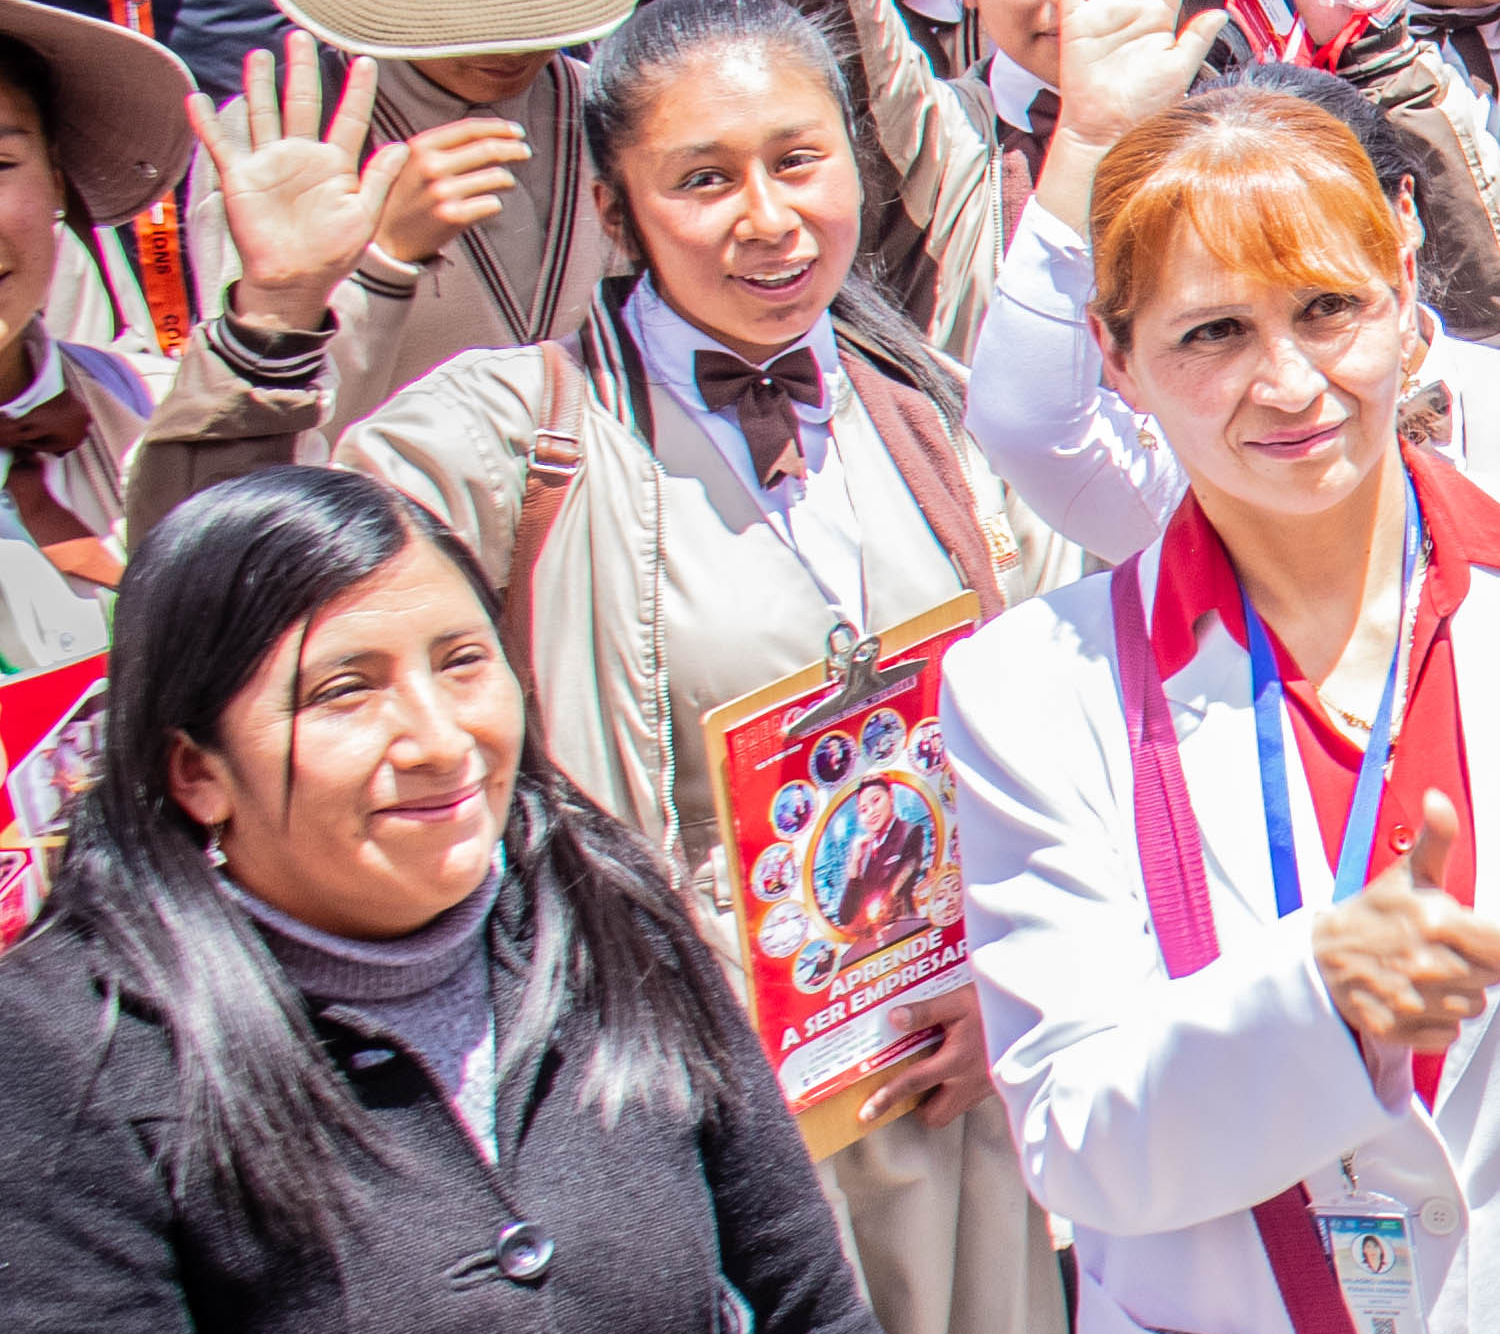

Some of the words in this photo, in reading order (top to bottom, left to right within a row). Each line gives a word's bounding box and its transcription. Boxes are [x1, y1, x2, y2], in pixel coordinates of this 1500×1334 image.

[780, 1027, 801, 1052] A
[804, 1001, 847, 1037] SER
[850, 938, 969, 1014] EMPRESAR
[828, 928, 944, 1001] APRENDE
